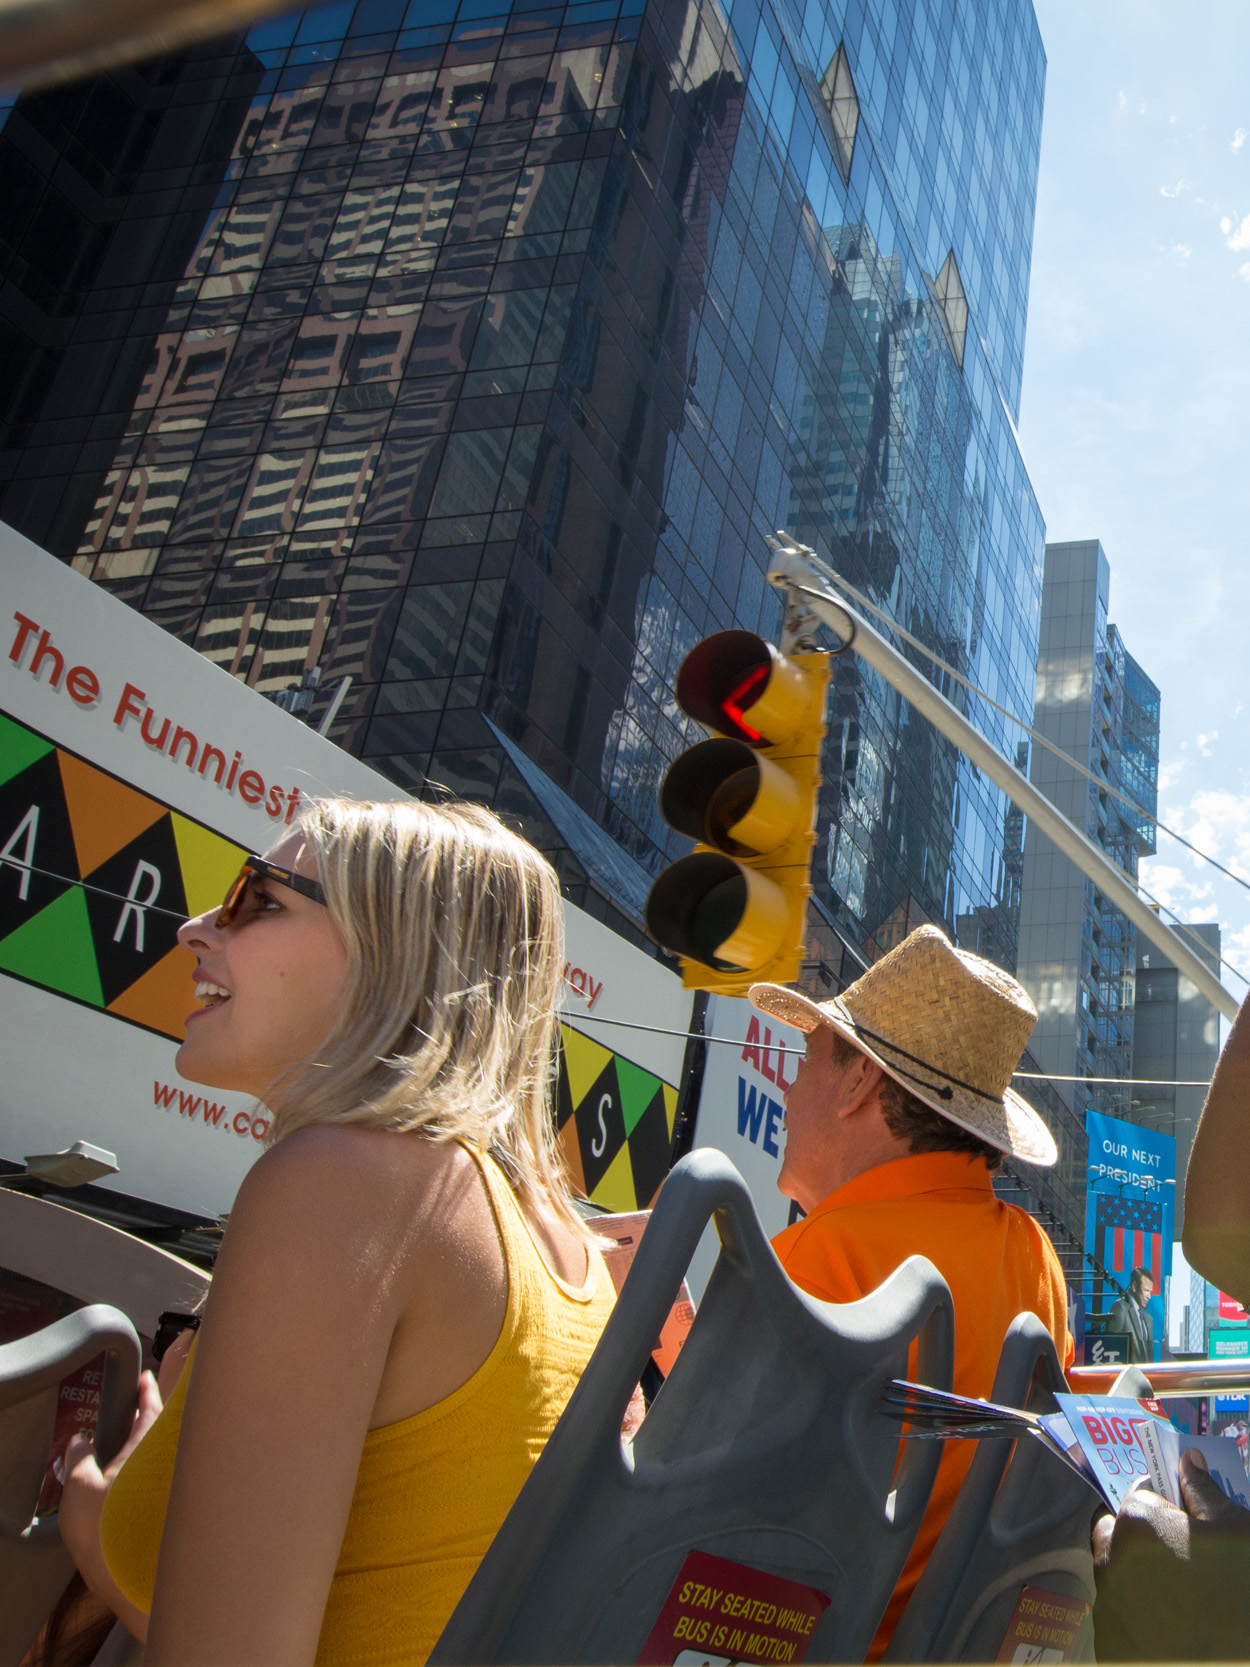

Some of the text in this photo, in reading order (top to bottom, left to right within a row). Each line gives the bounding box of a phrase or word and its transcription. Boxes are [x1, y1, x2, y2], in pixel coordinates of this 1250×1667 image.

[9, 611, 301, 826] The Funniest
[741, 1014, 790, 1092] ALL
[154, 1080, 273, 1143] www.ca
[1102, 1140, 1161, 1167] OUR NEXT
[1099, 1164, 1162, 1192] PRESIDENT
[60, 1386, 100, 1406] RESTA
[75, 1408, 100, 1423] SPA
[78, 1427, 96, 1440] FO
[1081, 1416, 1133, 1446] BIG
[1097, 1448, 1148, 1475] BUS
[1147, 1439, 1155, 1454] NEW
[1151, 1454, 1160, 1473] YORK
[1156, 1472, 1165, 1488] PASS
[679, 1581, 816, 1635] STAY SEATED WHILE
[1019, 1598, 1085, 1625] STAY SEATED WHILE
[673, 1616, 797, 1662] BUS IS IN MOTION
[1015, 1621, 1075, 1646] BUS IS IN MOTION
